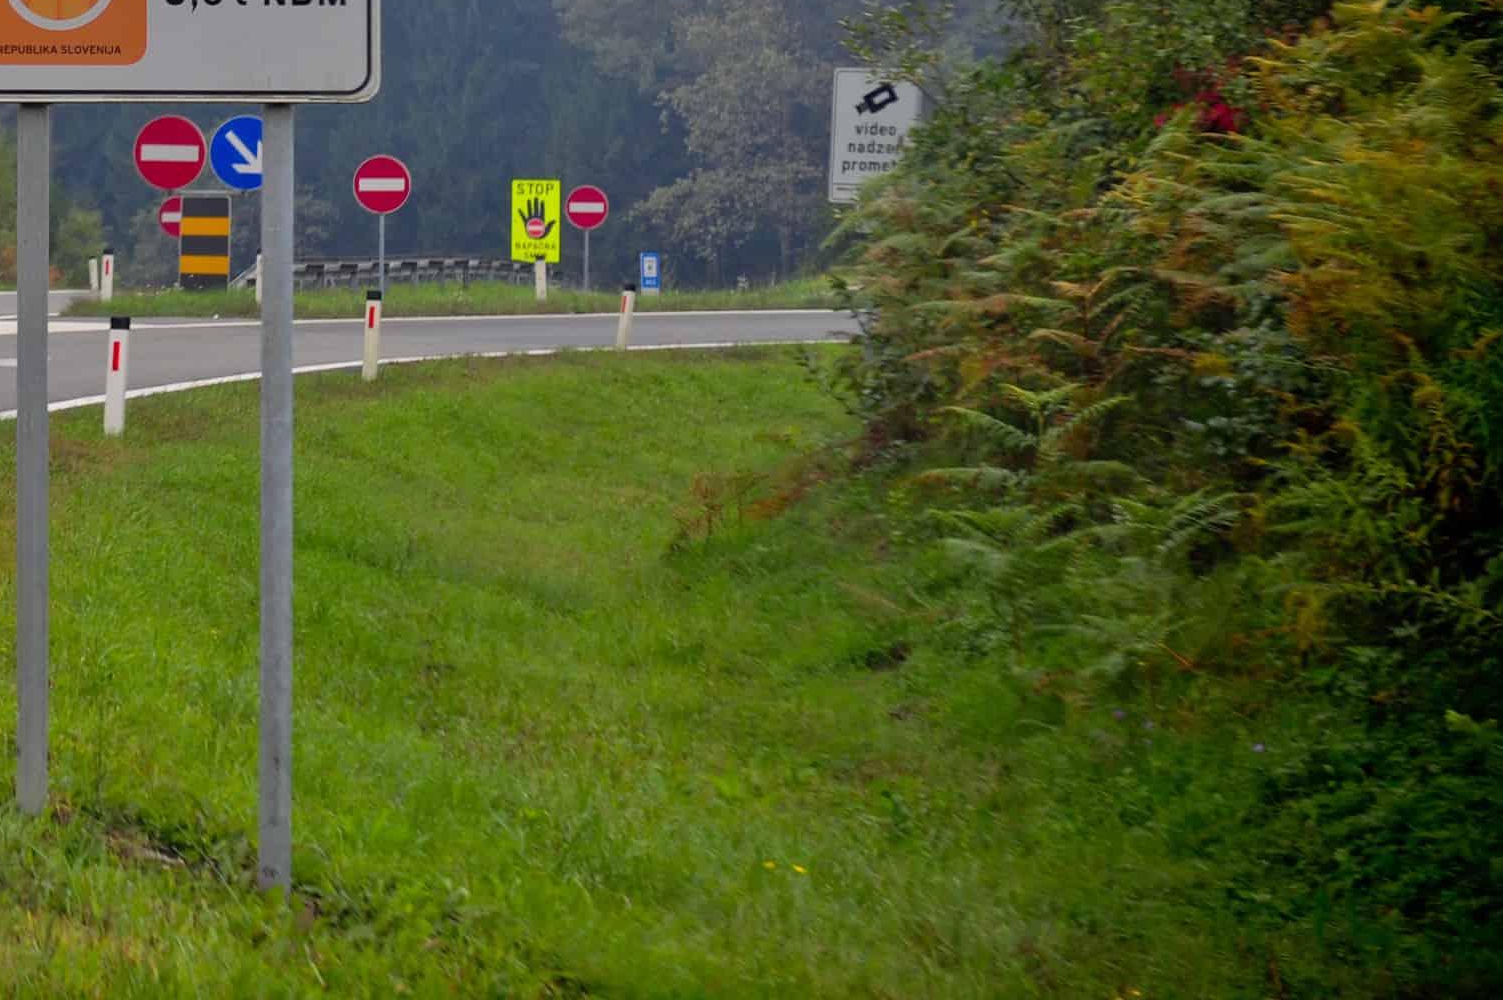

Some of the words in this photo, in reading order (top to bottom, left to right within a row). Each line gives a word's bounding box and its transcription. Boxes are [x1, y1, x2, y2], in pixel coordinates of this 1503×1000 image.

[60, 44, 122, 55] SLOVENIJA
[854, 122, 897, 137] video
[516, 183, 554, 195] STOP
